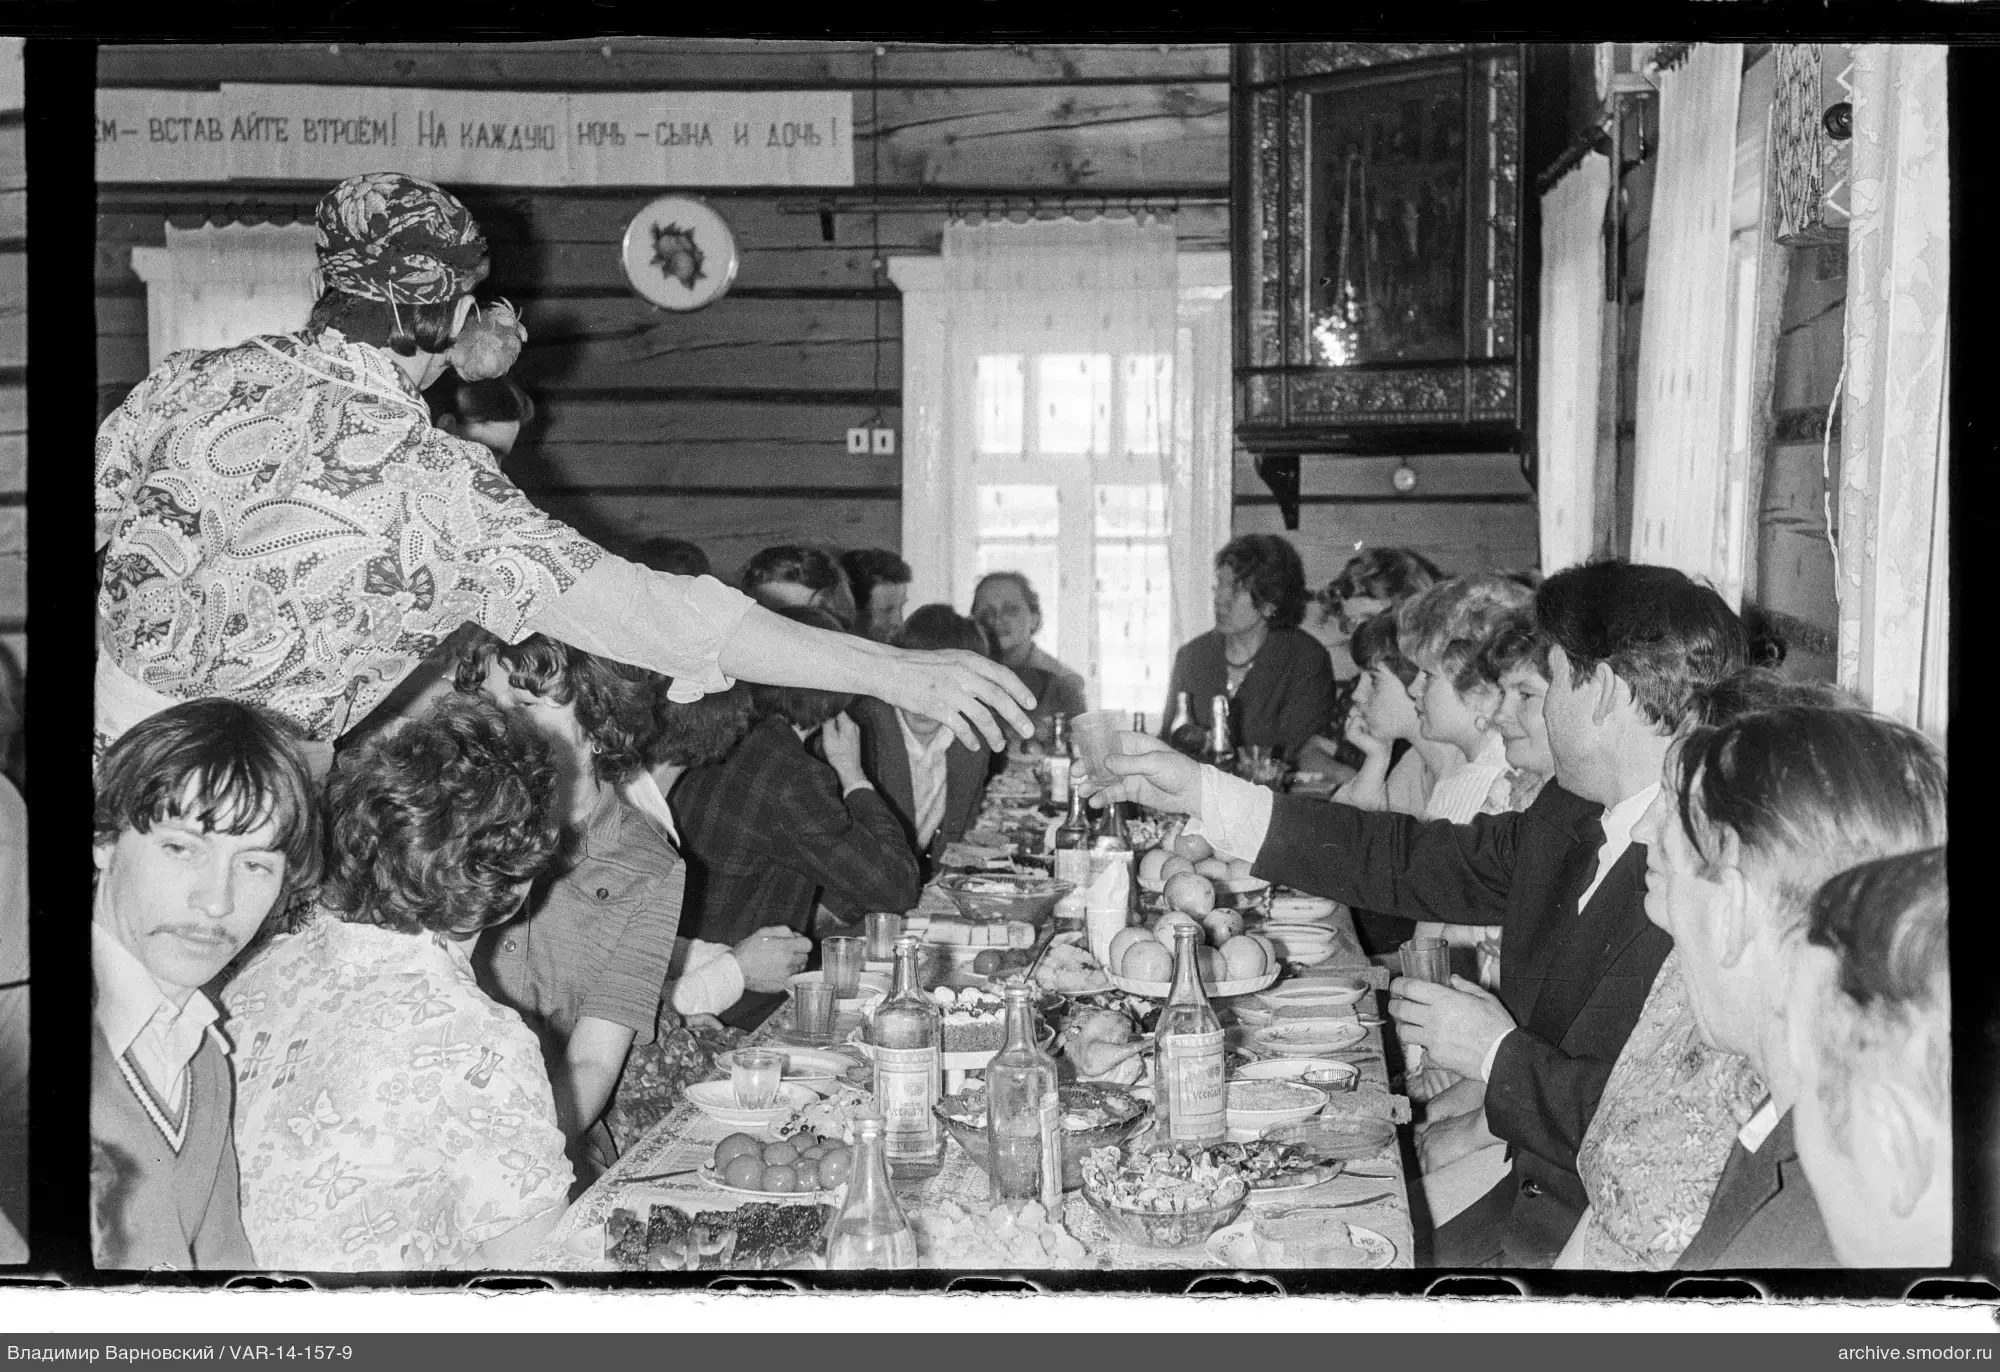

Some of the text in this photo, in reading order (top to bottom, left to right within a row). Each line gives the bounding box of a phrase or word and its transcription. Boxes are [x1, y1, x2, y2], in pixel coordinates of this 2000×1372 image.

[302, 112, 398, 147] ВТРОЁМ!
[459, 121, 556, 151] КАЖДУЮ
[577, 121, 626, 146] НОЧЬ
[655, 121, 713, 146] СЫНА
[734, 121, 749, 147] И
